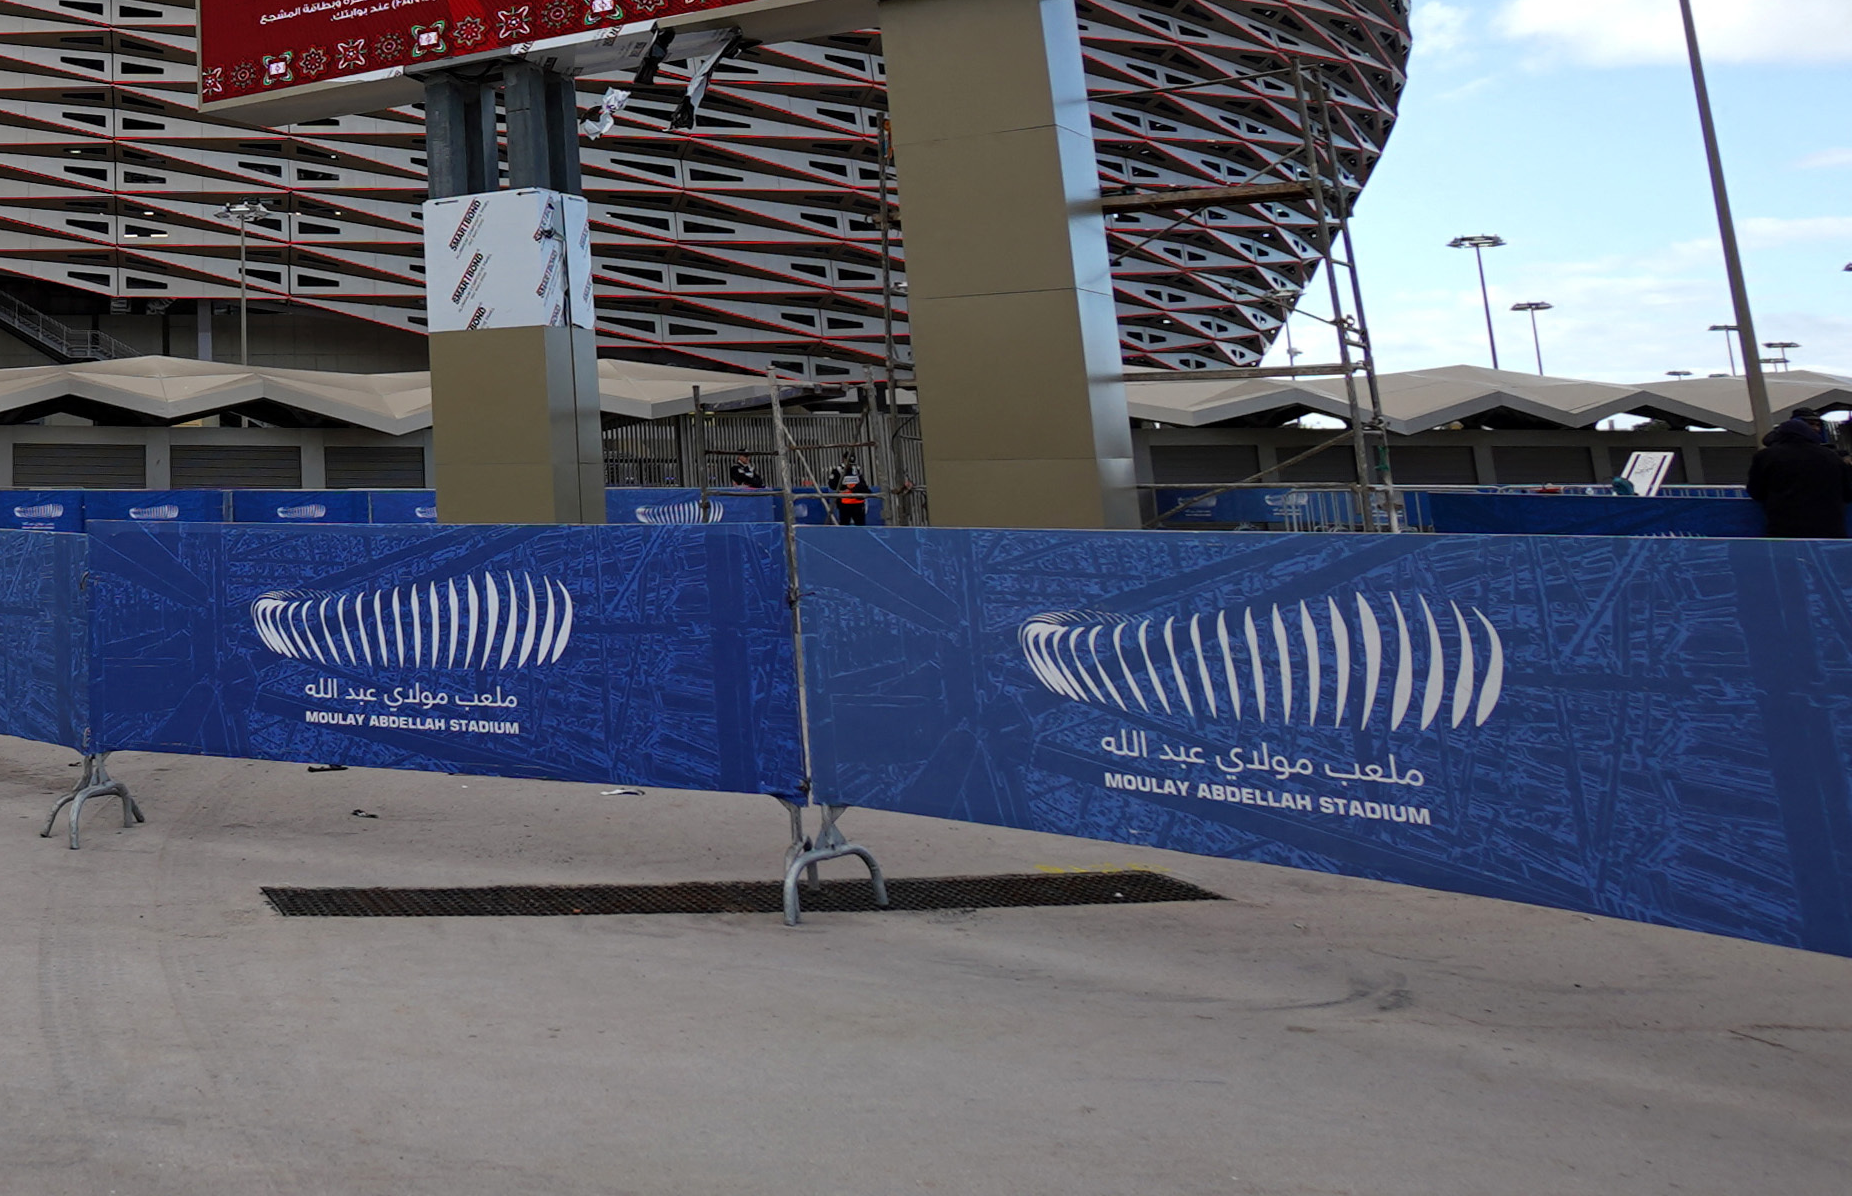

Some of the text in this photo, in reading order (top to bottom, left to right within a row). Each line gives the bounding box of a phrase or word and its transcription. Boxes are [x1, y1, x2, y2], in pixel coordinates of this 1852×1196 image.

[260, 7, 301, 25] المشجع
[370, 1, 389, 15] عند
[449, 199, 481, 252] SMARTBOND
[451, 253, 483, 305] SMARTBOND
[304, 678, 518, 711] ملعب مولاي عبد الله
[305, 710, 520, 735] MOULAY ABDELLAH STADIUM
[1100, 727, 1426, 787] ملعب مولاي عبد الله
[1104, 771, 1432, 826] MOULAY ABDELLAH STADIUM
